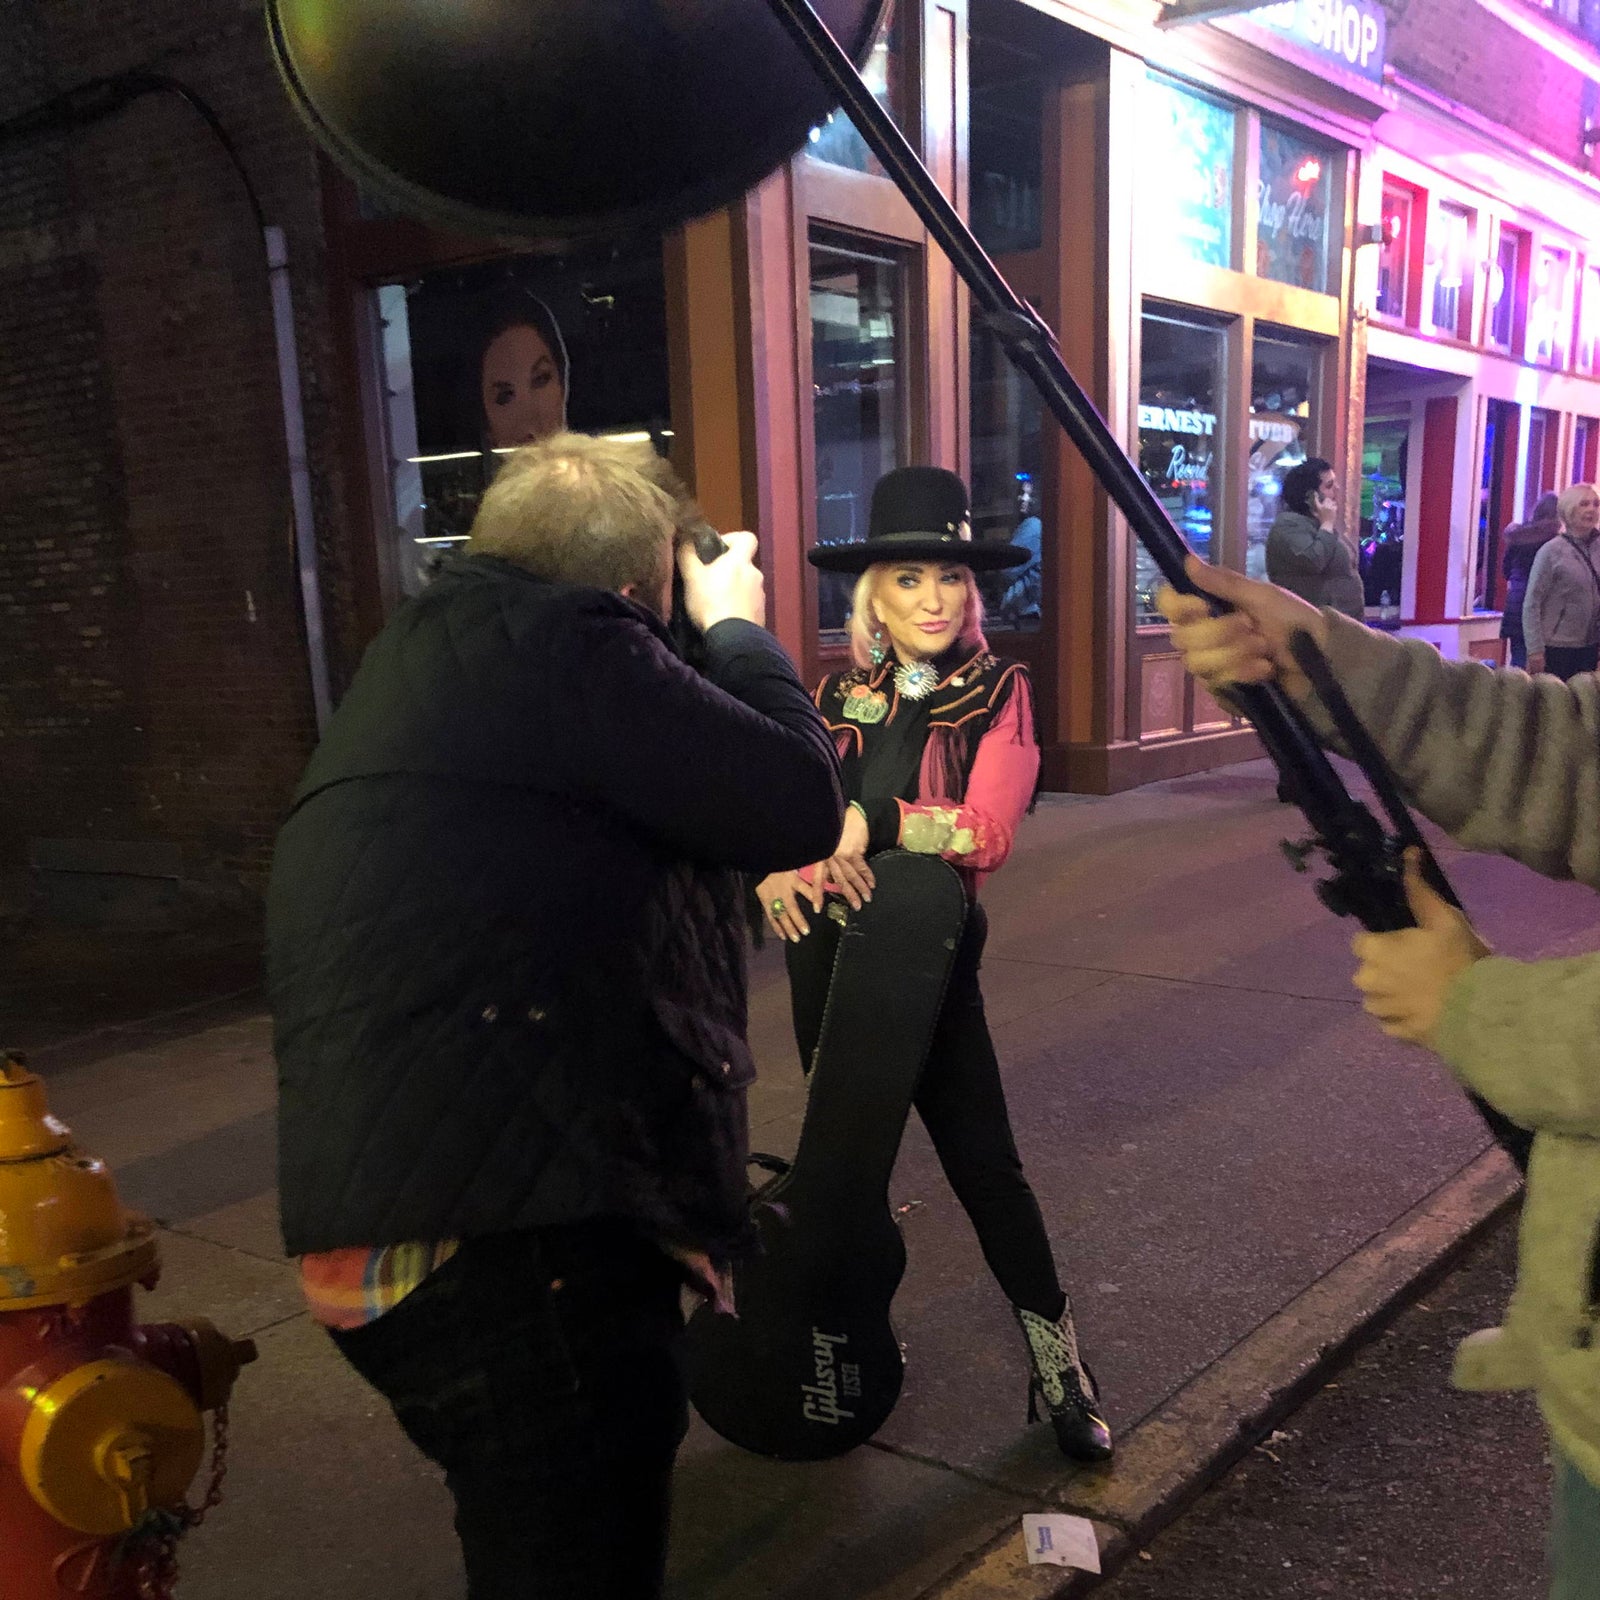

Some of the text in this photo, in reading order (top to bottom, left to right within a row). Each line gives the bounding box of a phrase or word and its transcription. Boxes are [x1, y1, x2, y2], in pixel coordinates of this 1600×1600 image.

[1305, 0, 1377, 67] SHOP
[1138, 404, 1216, 436] ERNEST
[801, 1326, 855, 1425] Gibson
[840, 1362, 862, 1397] USA
